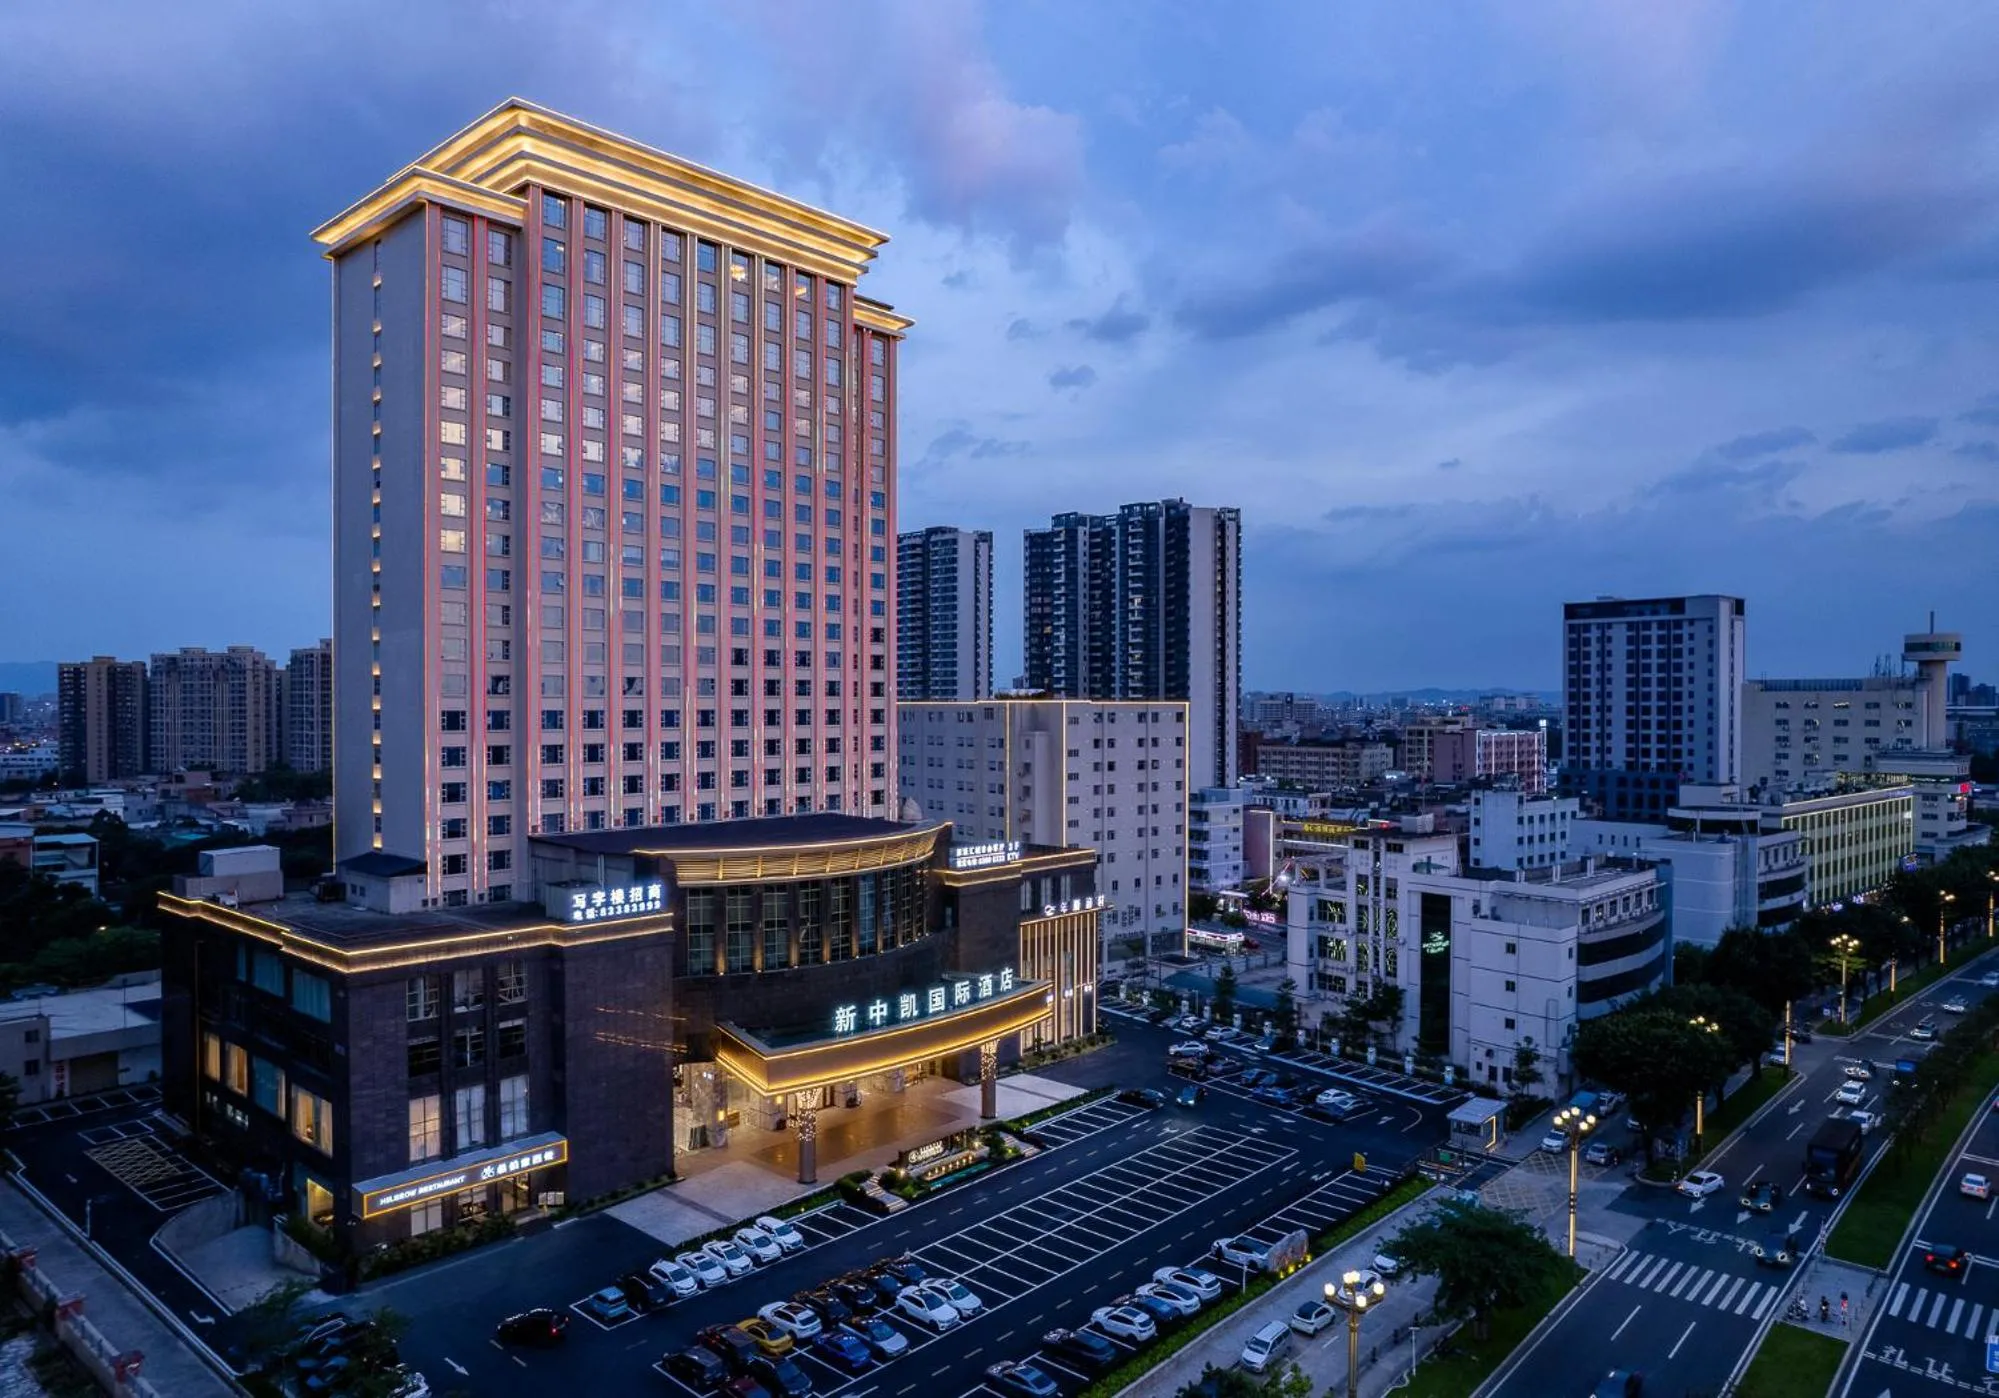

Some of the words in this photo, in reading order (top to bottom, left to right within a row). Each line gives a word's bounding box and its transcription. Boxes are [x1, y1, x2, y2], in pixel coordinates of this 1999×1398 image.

[572, 884, 661, 909] 写字楼招商
[834, 967, 1013, 1032] 新中凯国际酒店
[418, 1176, 466, 1194] RESTAURANT
